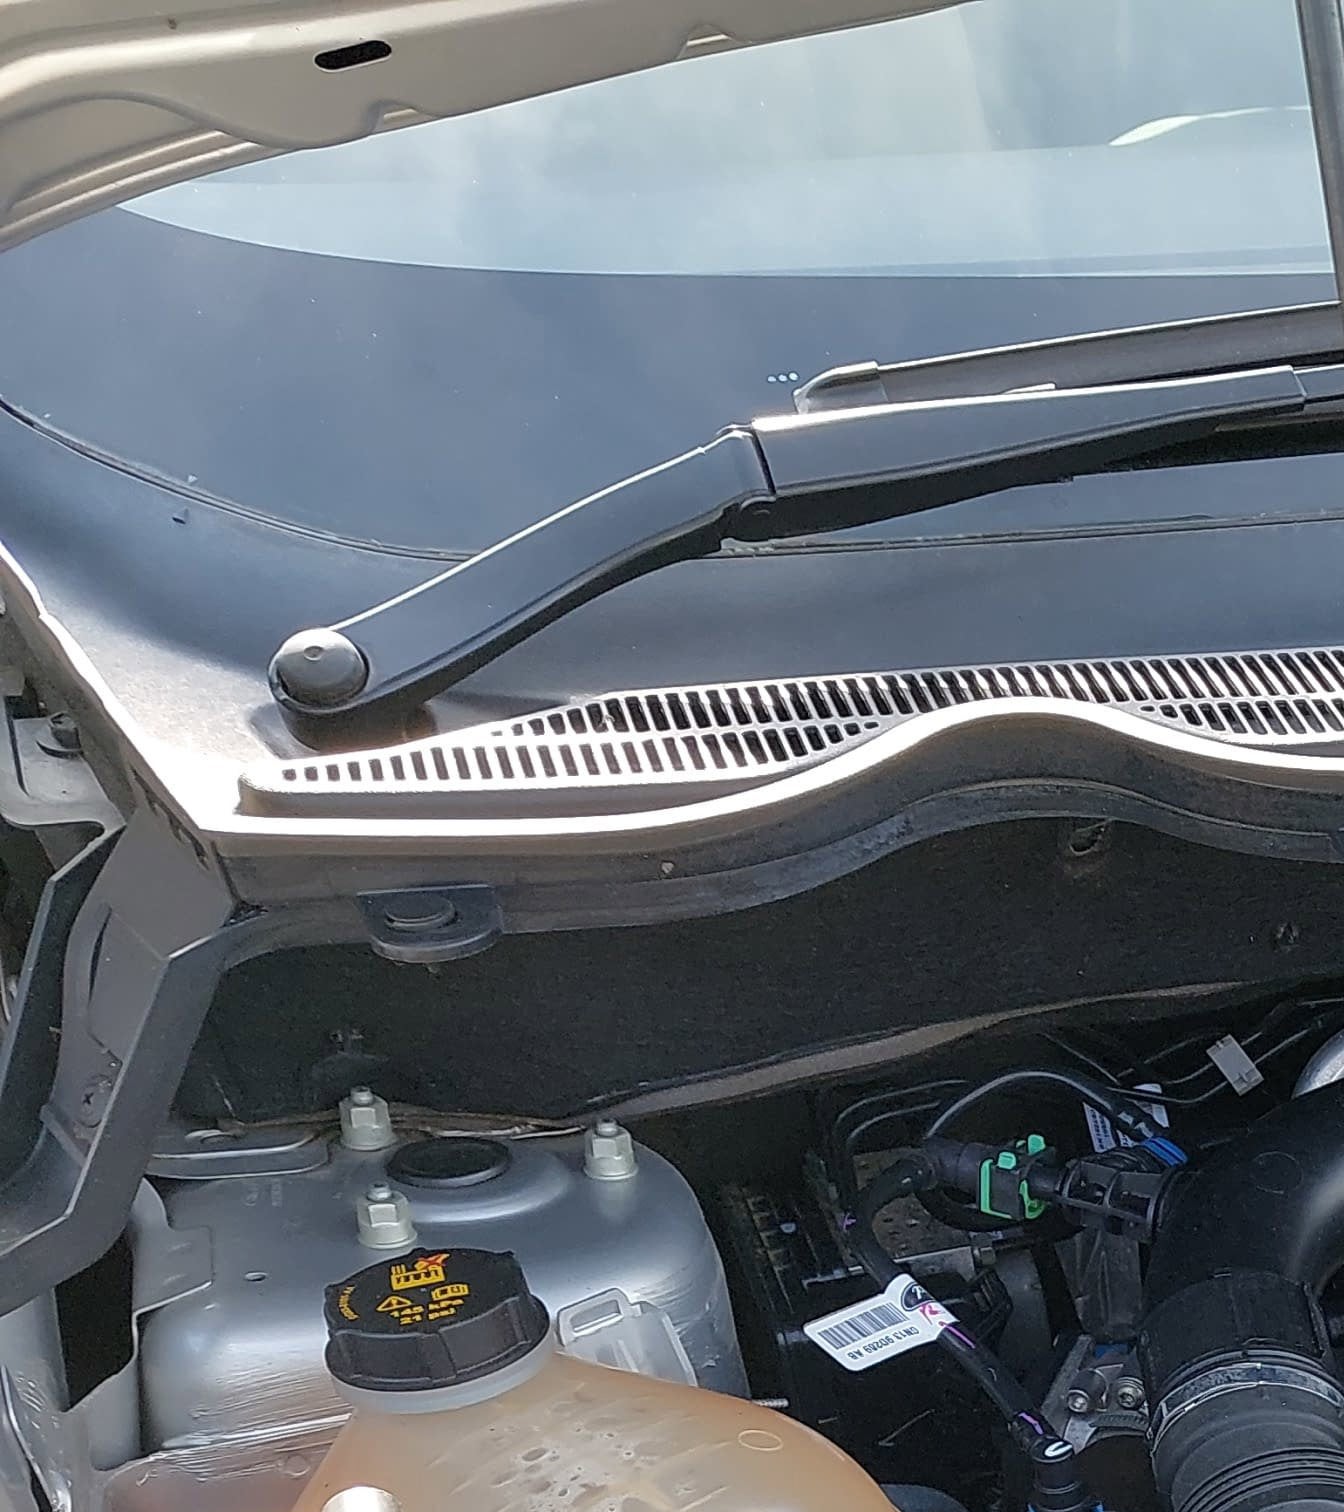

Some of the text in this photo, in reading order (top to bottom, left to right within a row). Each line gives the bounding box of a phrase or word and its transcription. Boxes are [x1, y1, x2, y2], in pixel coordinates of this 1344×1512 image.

[390, 1304, 424, 1318] 145
[399, 1307, 457, 1326] 21 psi
